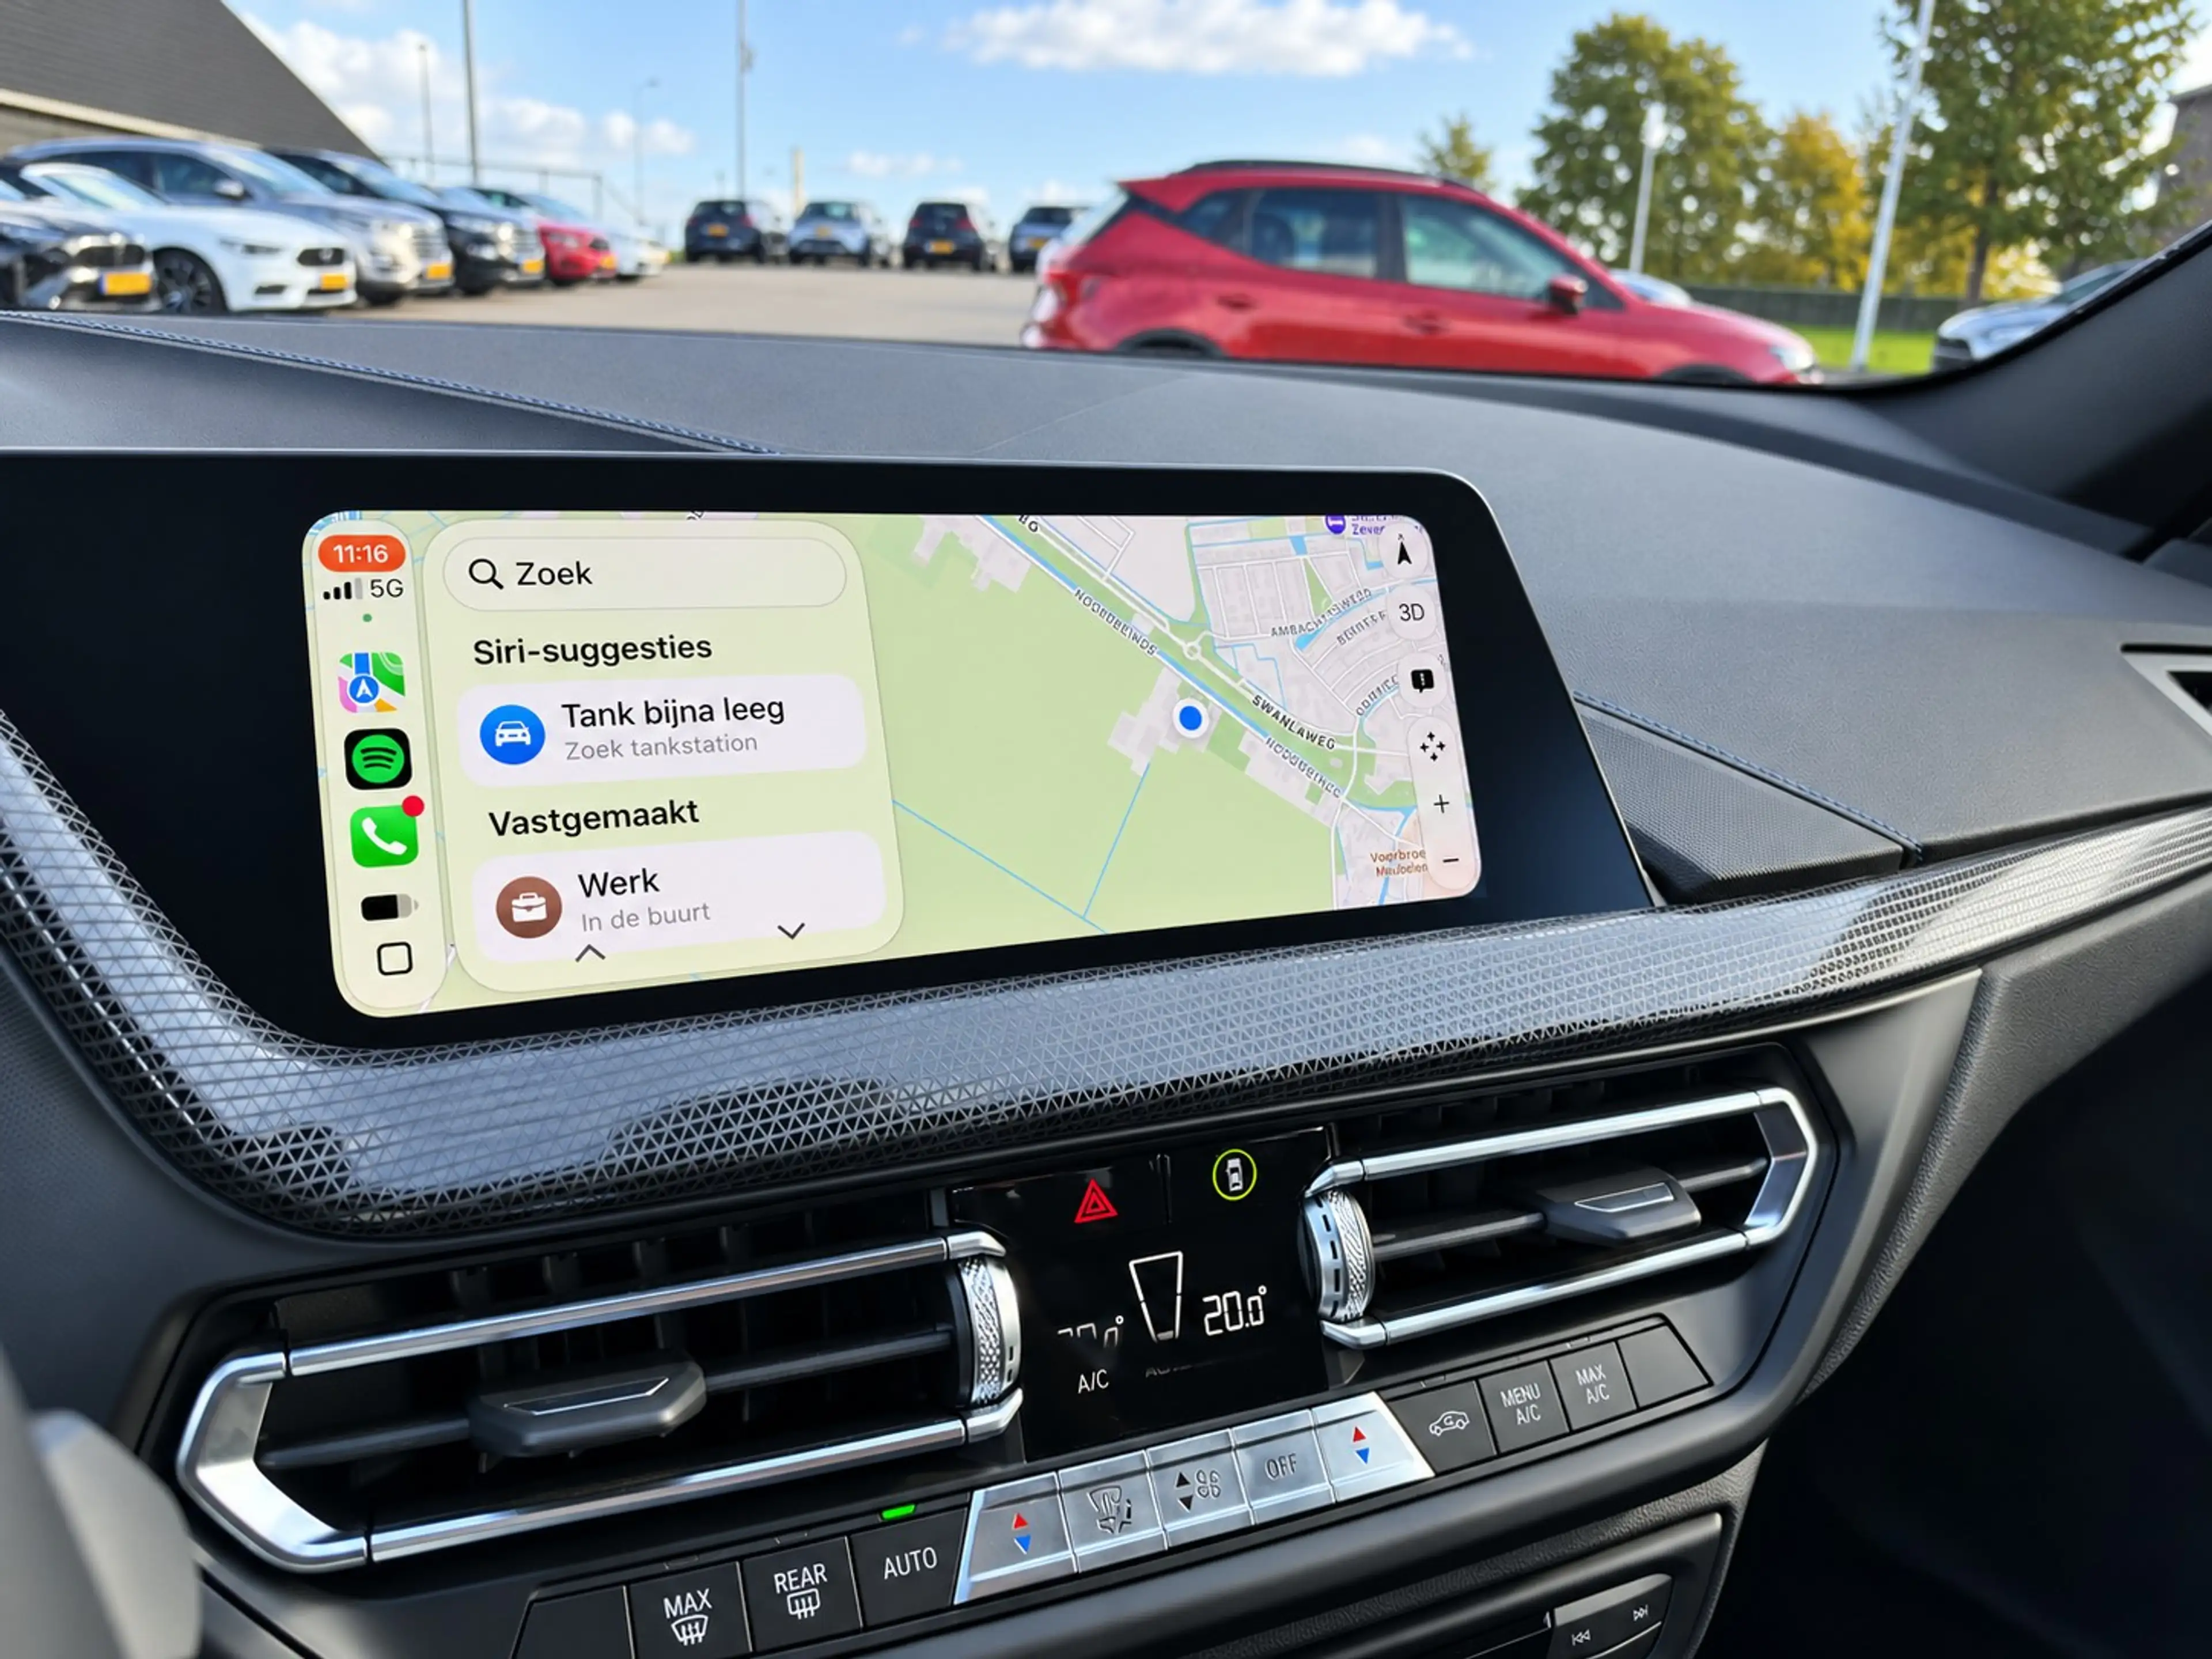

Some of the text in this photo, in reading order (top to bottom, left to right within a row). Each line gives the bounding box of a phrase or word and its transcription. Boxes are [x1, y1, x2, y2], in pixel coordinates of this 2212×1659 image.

[333, 544, 389, 564] 11:16
[516, 561, 593, 586] Zoek
[370, 578, 404, 599] 5G
[1399, 603, 1425, 622] 3D
[474, 635, 713, 668] Siri-suggesties
[562, 697, 785, 728] Tank bijna leeg
[1252, 695, 1336, 751] SWANLAWEG
[565, 733, 757, 761] Zoek tankstation
[489, 800, 700, 837] Vastgemaakt
[578, 868, 661, 899] Werk
[582, 903, 711, 932] In de buurt
[1077, 1369, 1109, 1395] A/C
[1575, 1363, 1607, 1386] MAX
[1500, 1383, 1541, 1407] MENU
[1586, 1385, 1610, 1404] A/C
[1515, 1404, 1541, 1426] A/C
[1266, 1452, 1298, 1481] OFF
[883, 1547, 938, 1580] AUTO
[774, 1563, 828, 1594] REAR
[663, 1589, 713, 1619] MAX
